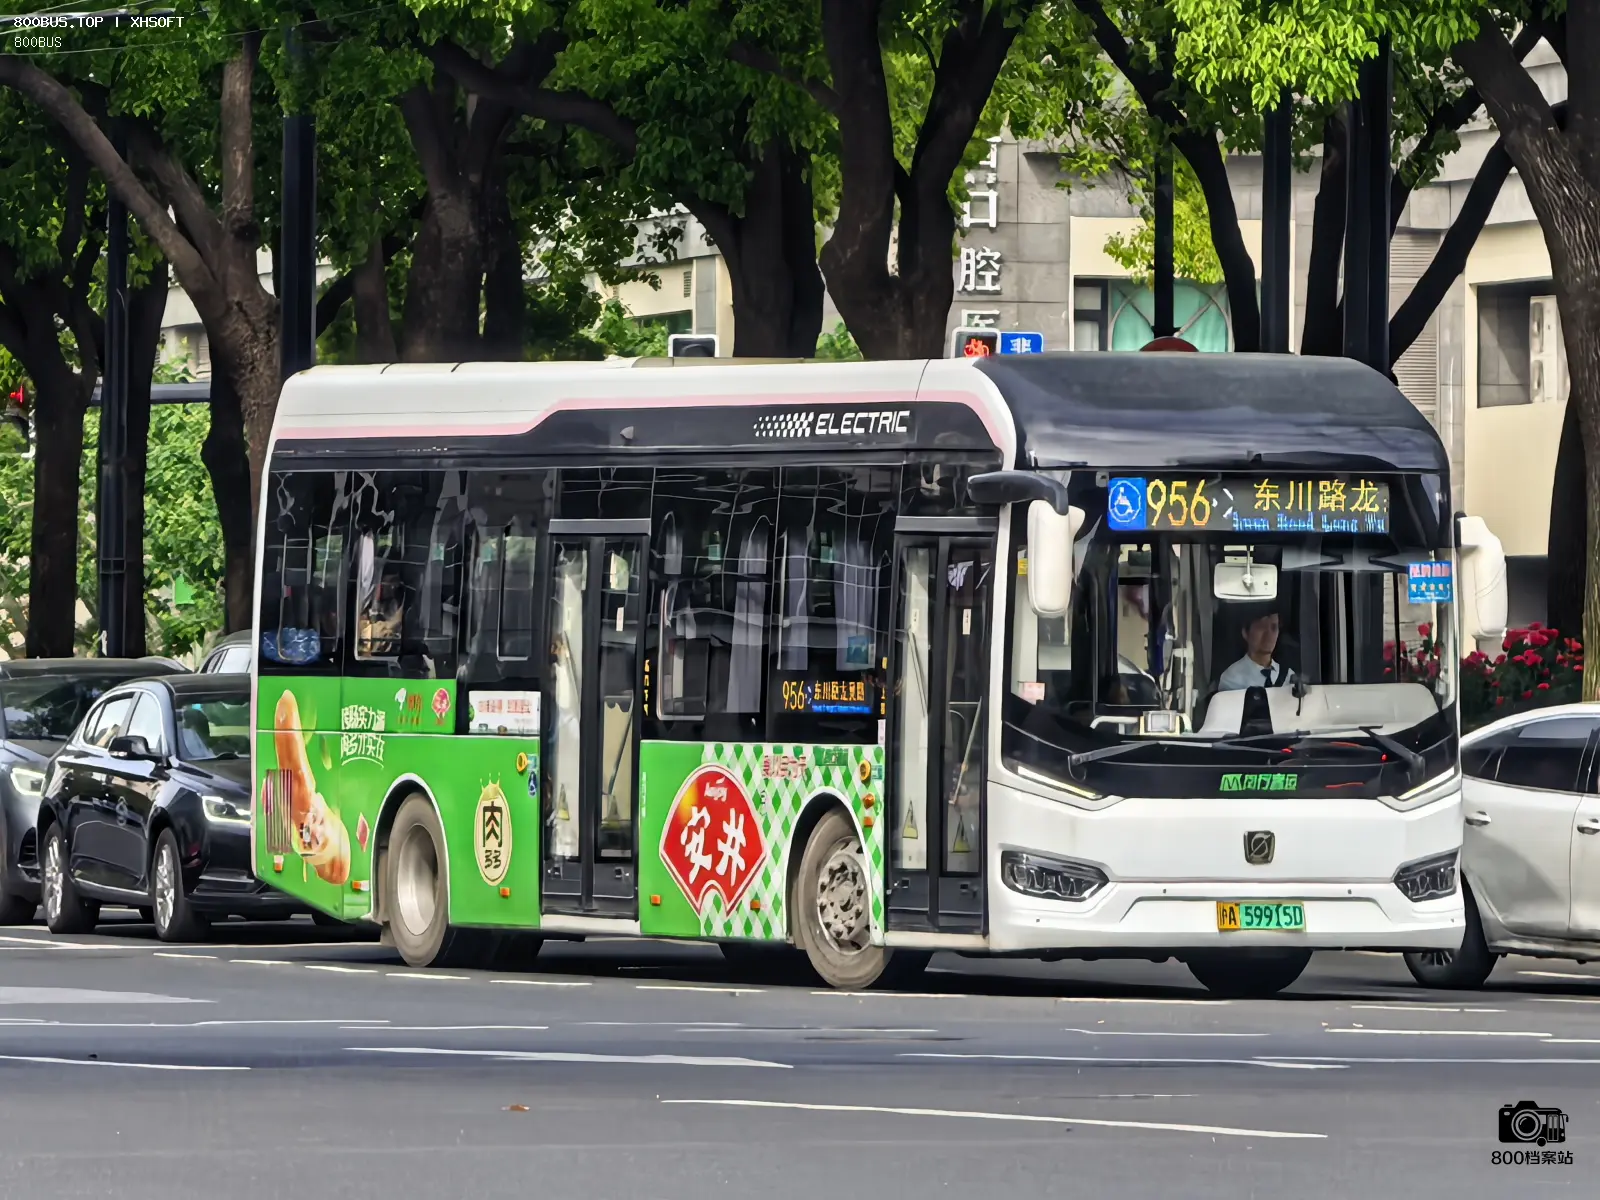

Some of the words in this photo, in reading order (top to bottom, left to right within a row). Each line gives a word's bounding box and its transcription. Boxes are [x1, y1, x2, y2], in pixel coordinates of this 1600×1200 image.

[815, 410, 911, 435] ELECTRIC
[1146, 478, 1211, 526] 956
[782, 680, 805, 710] 956
